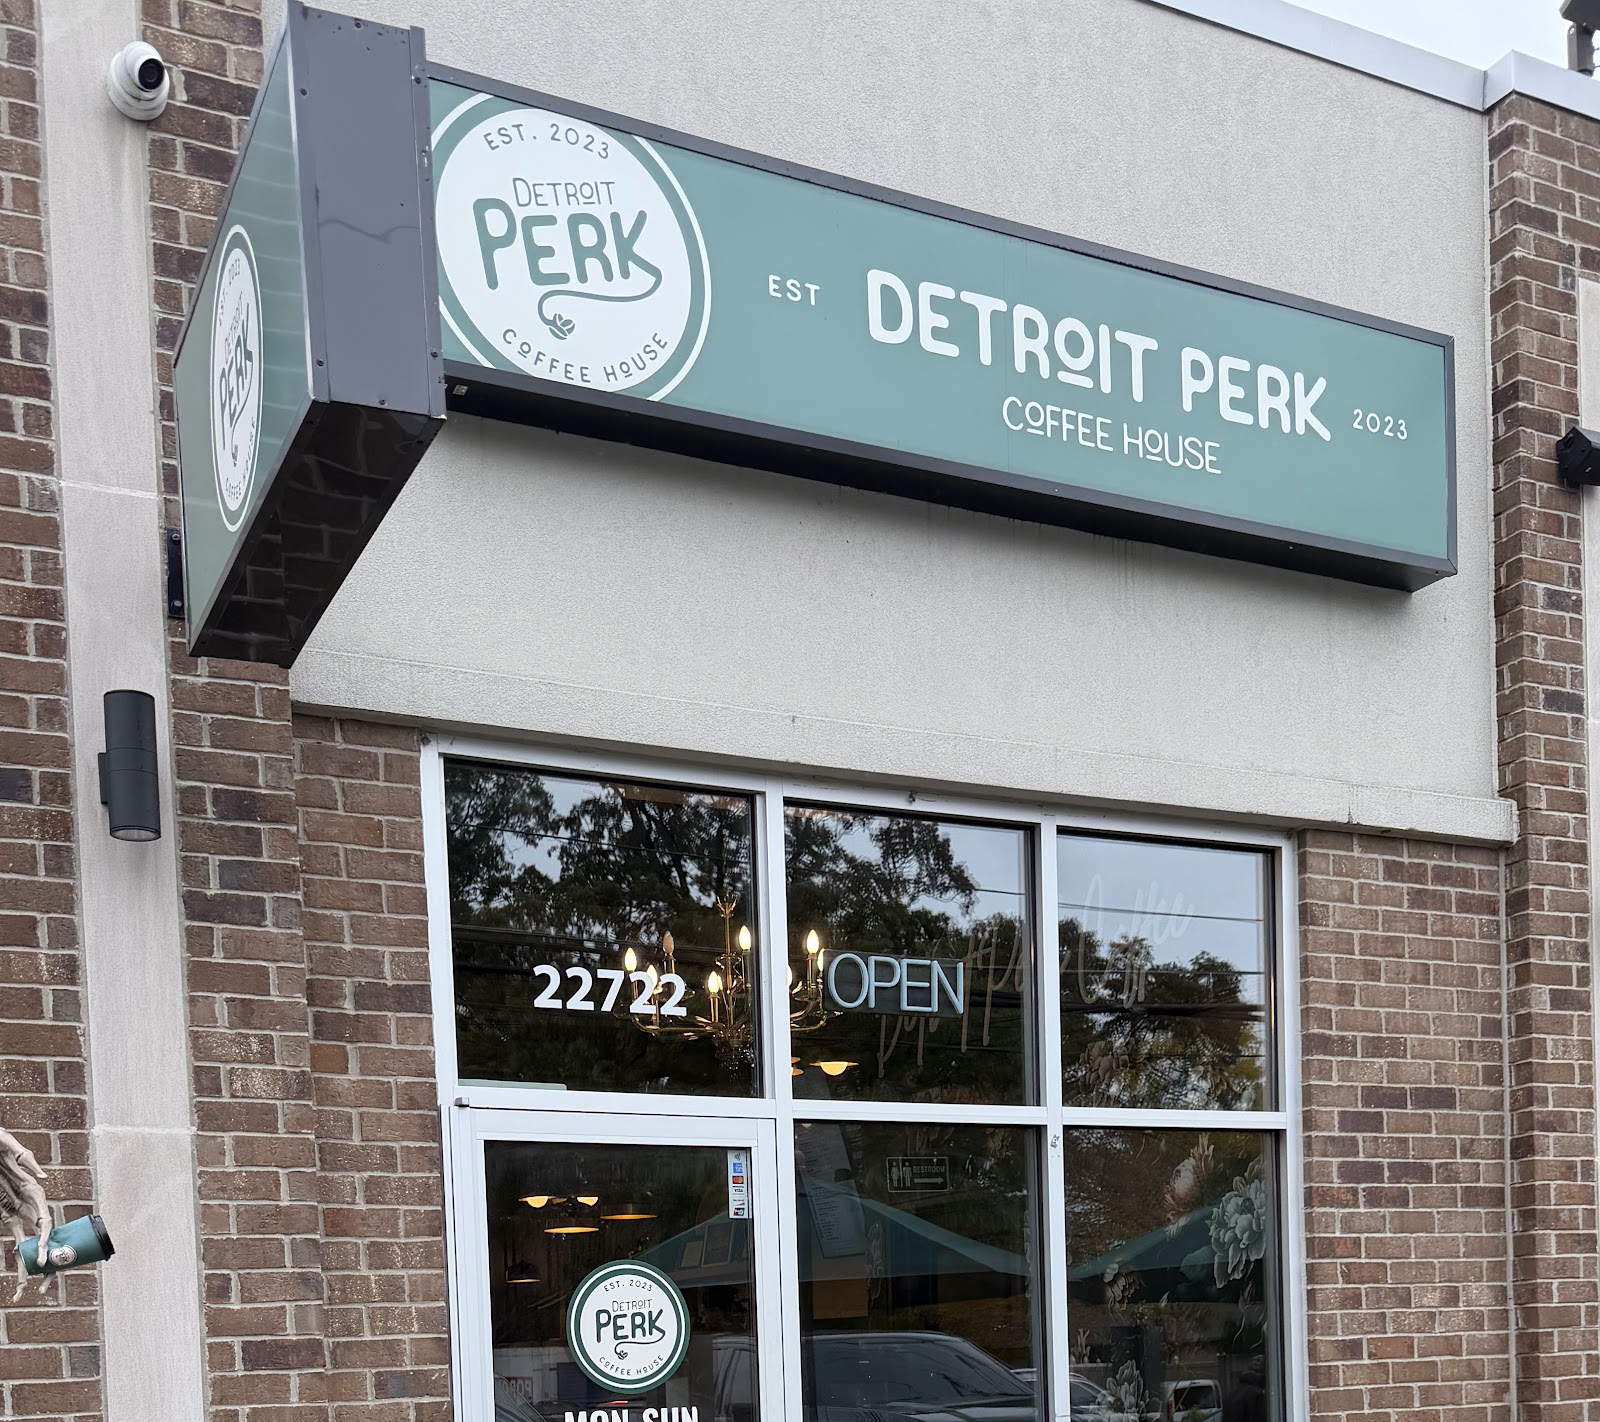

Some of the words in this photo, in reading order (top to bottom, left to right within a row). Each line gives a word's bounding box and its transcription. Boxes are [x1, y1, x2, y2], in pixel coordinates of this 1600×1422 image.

[484, 124, 537, 150] EST.
[550, 123, 609, 159] 2023
[512, 177, 615, 207] DETROIT
[472, 197, 663, 291] PERK
[768, 274, 820, 306] EST
[502, 328, 591, 383] COFFEE
[603, 333, 668, 382] HOUSE
[867, 268, 1159, 402] DETROIT
[1181, 346, 1331, 442] PERK
[219, 301, 254, 451] PERK
[1002, 396, 1114, 452] COFFEE
[1123, 422, 1222, 475] HOUSE
[1352, 408, 1408, 440] 2023
[225, 477, 242, 502] COFFEE
[532, 963, 688, 1018] 22722
[827, 952, 964, 1015] OPEN
[912, 1165, 946, 1174] RESTROOM
[603, 1280, 626, 1292] EST.
[629, 1279, 653, 1292] 2023
[611, 1298, 653, 1313] DETROIT
[595, 1308, 666, 1344] PERK
[599, 1356, 632, 1376] COFFEE
[636, 1354, 664, 1376] HOUSE
